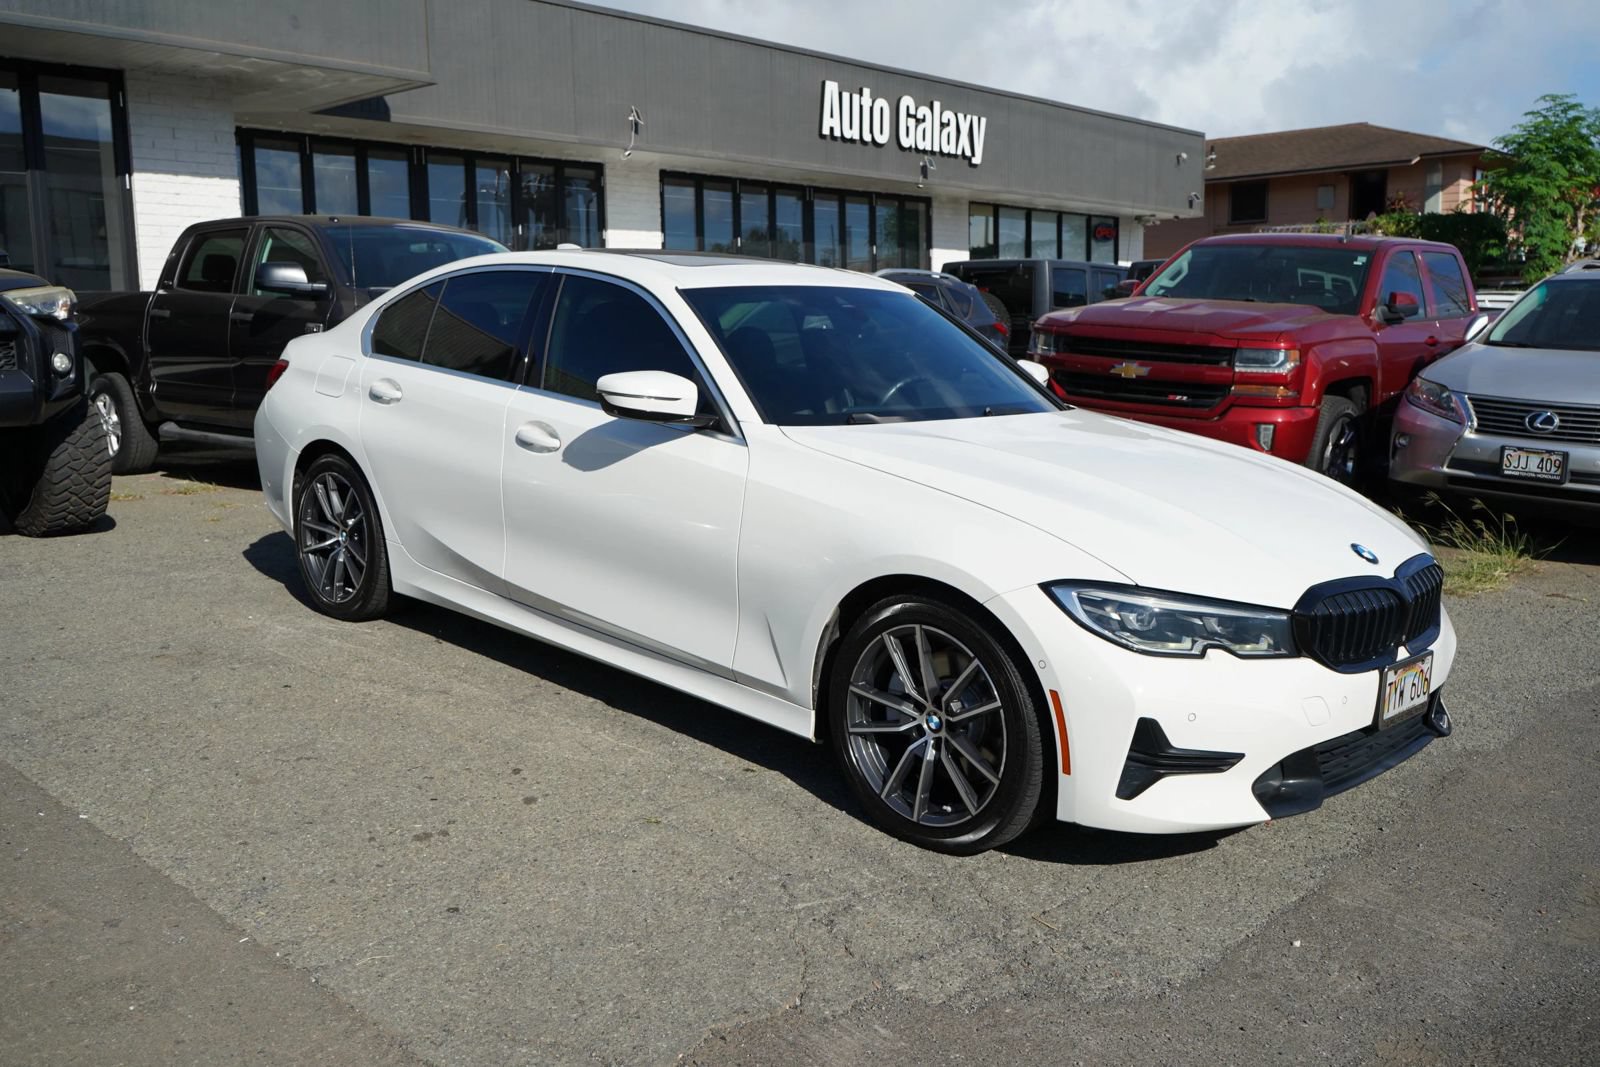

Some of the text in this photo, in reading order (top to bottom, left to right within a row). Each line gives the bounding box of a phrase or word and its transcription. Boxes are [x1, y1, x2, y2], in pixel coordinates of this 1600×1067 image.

[820, 79, 988, 166] Auto Galaxy
[1504, 453, 1562, 474] SJJ 409
[1410, 666, 1430, 701] 606
